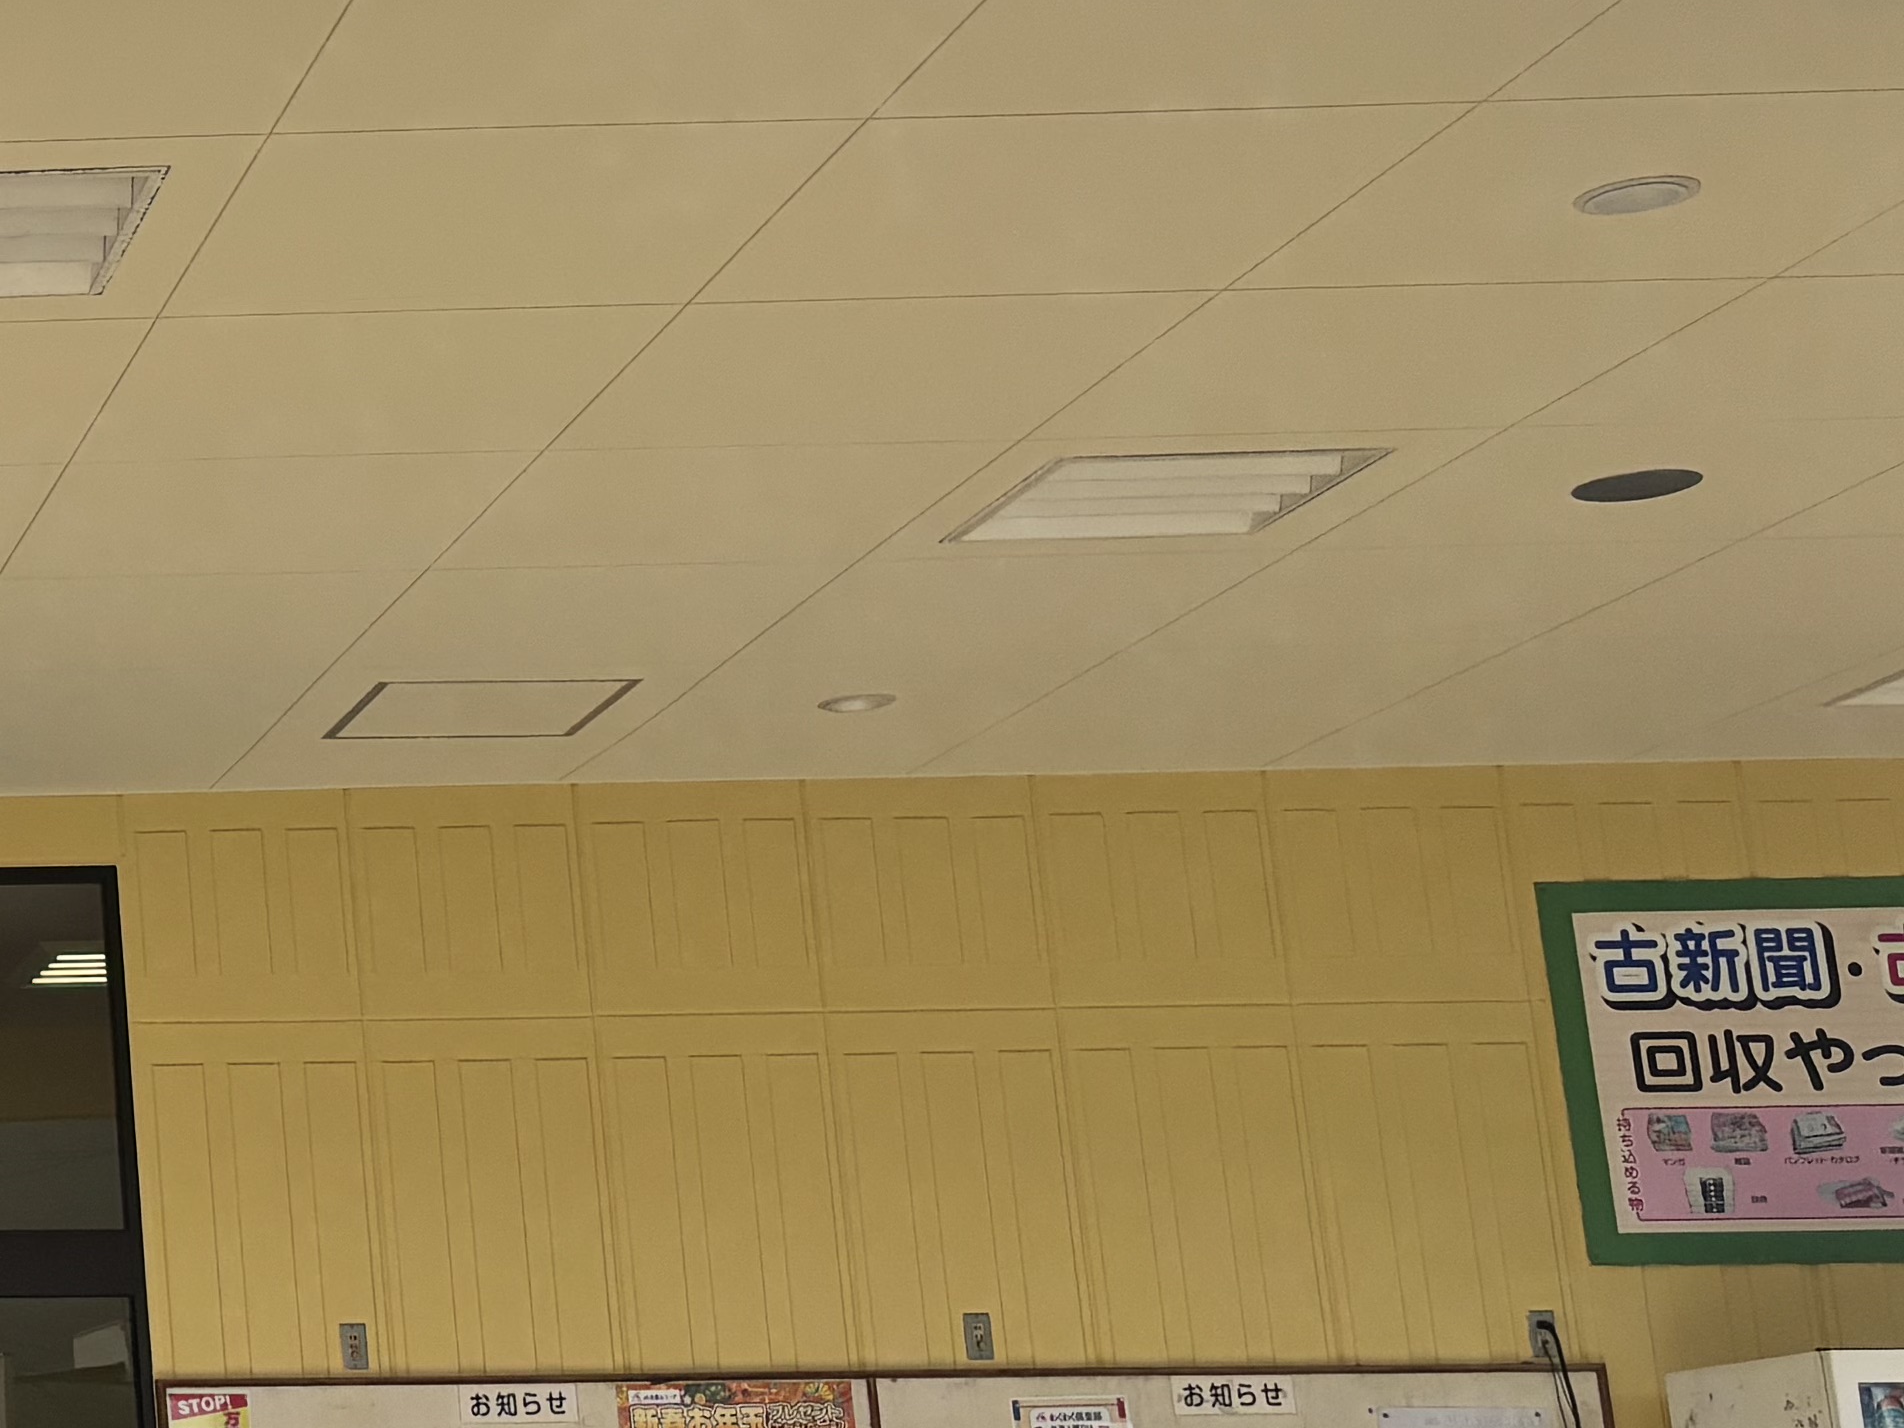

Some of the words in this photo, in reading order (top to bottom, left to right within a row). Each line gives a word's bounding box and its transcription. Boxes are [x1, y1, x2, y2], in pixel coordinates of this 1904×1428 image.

[177, 1395, 232, 1415] STOP!
[469, 1390, 567, 1417] お知らせ
[1184, 1382, 1283, 1408] お知らせ
